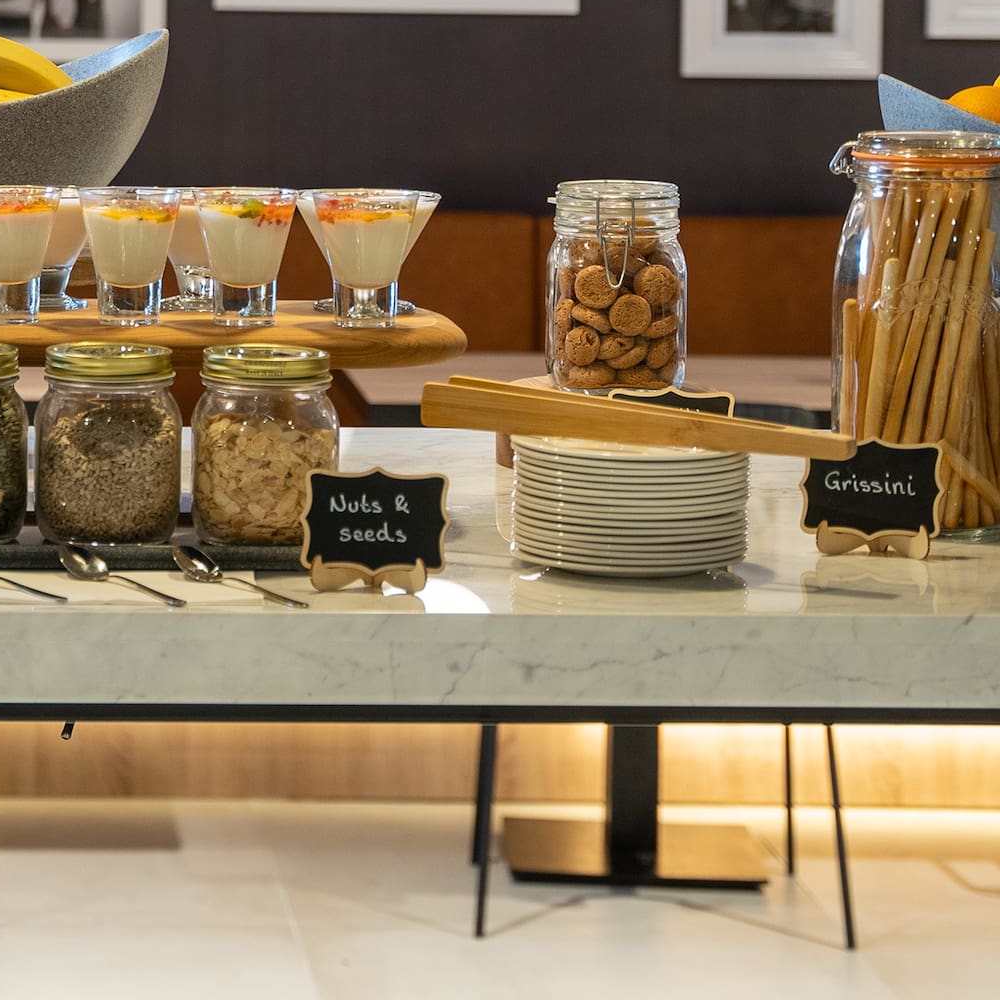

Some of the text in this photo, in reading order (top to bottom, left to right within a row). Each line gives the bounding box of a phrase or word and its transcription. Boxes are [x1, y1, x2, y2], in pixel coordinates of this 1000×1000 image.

[824, 470, 916, 496] Grissini
[330, 494, 410, 514] Nuts &
[339, 522, 407, 543] seeds
